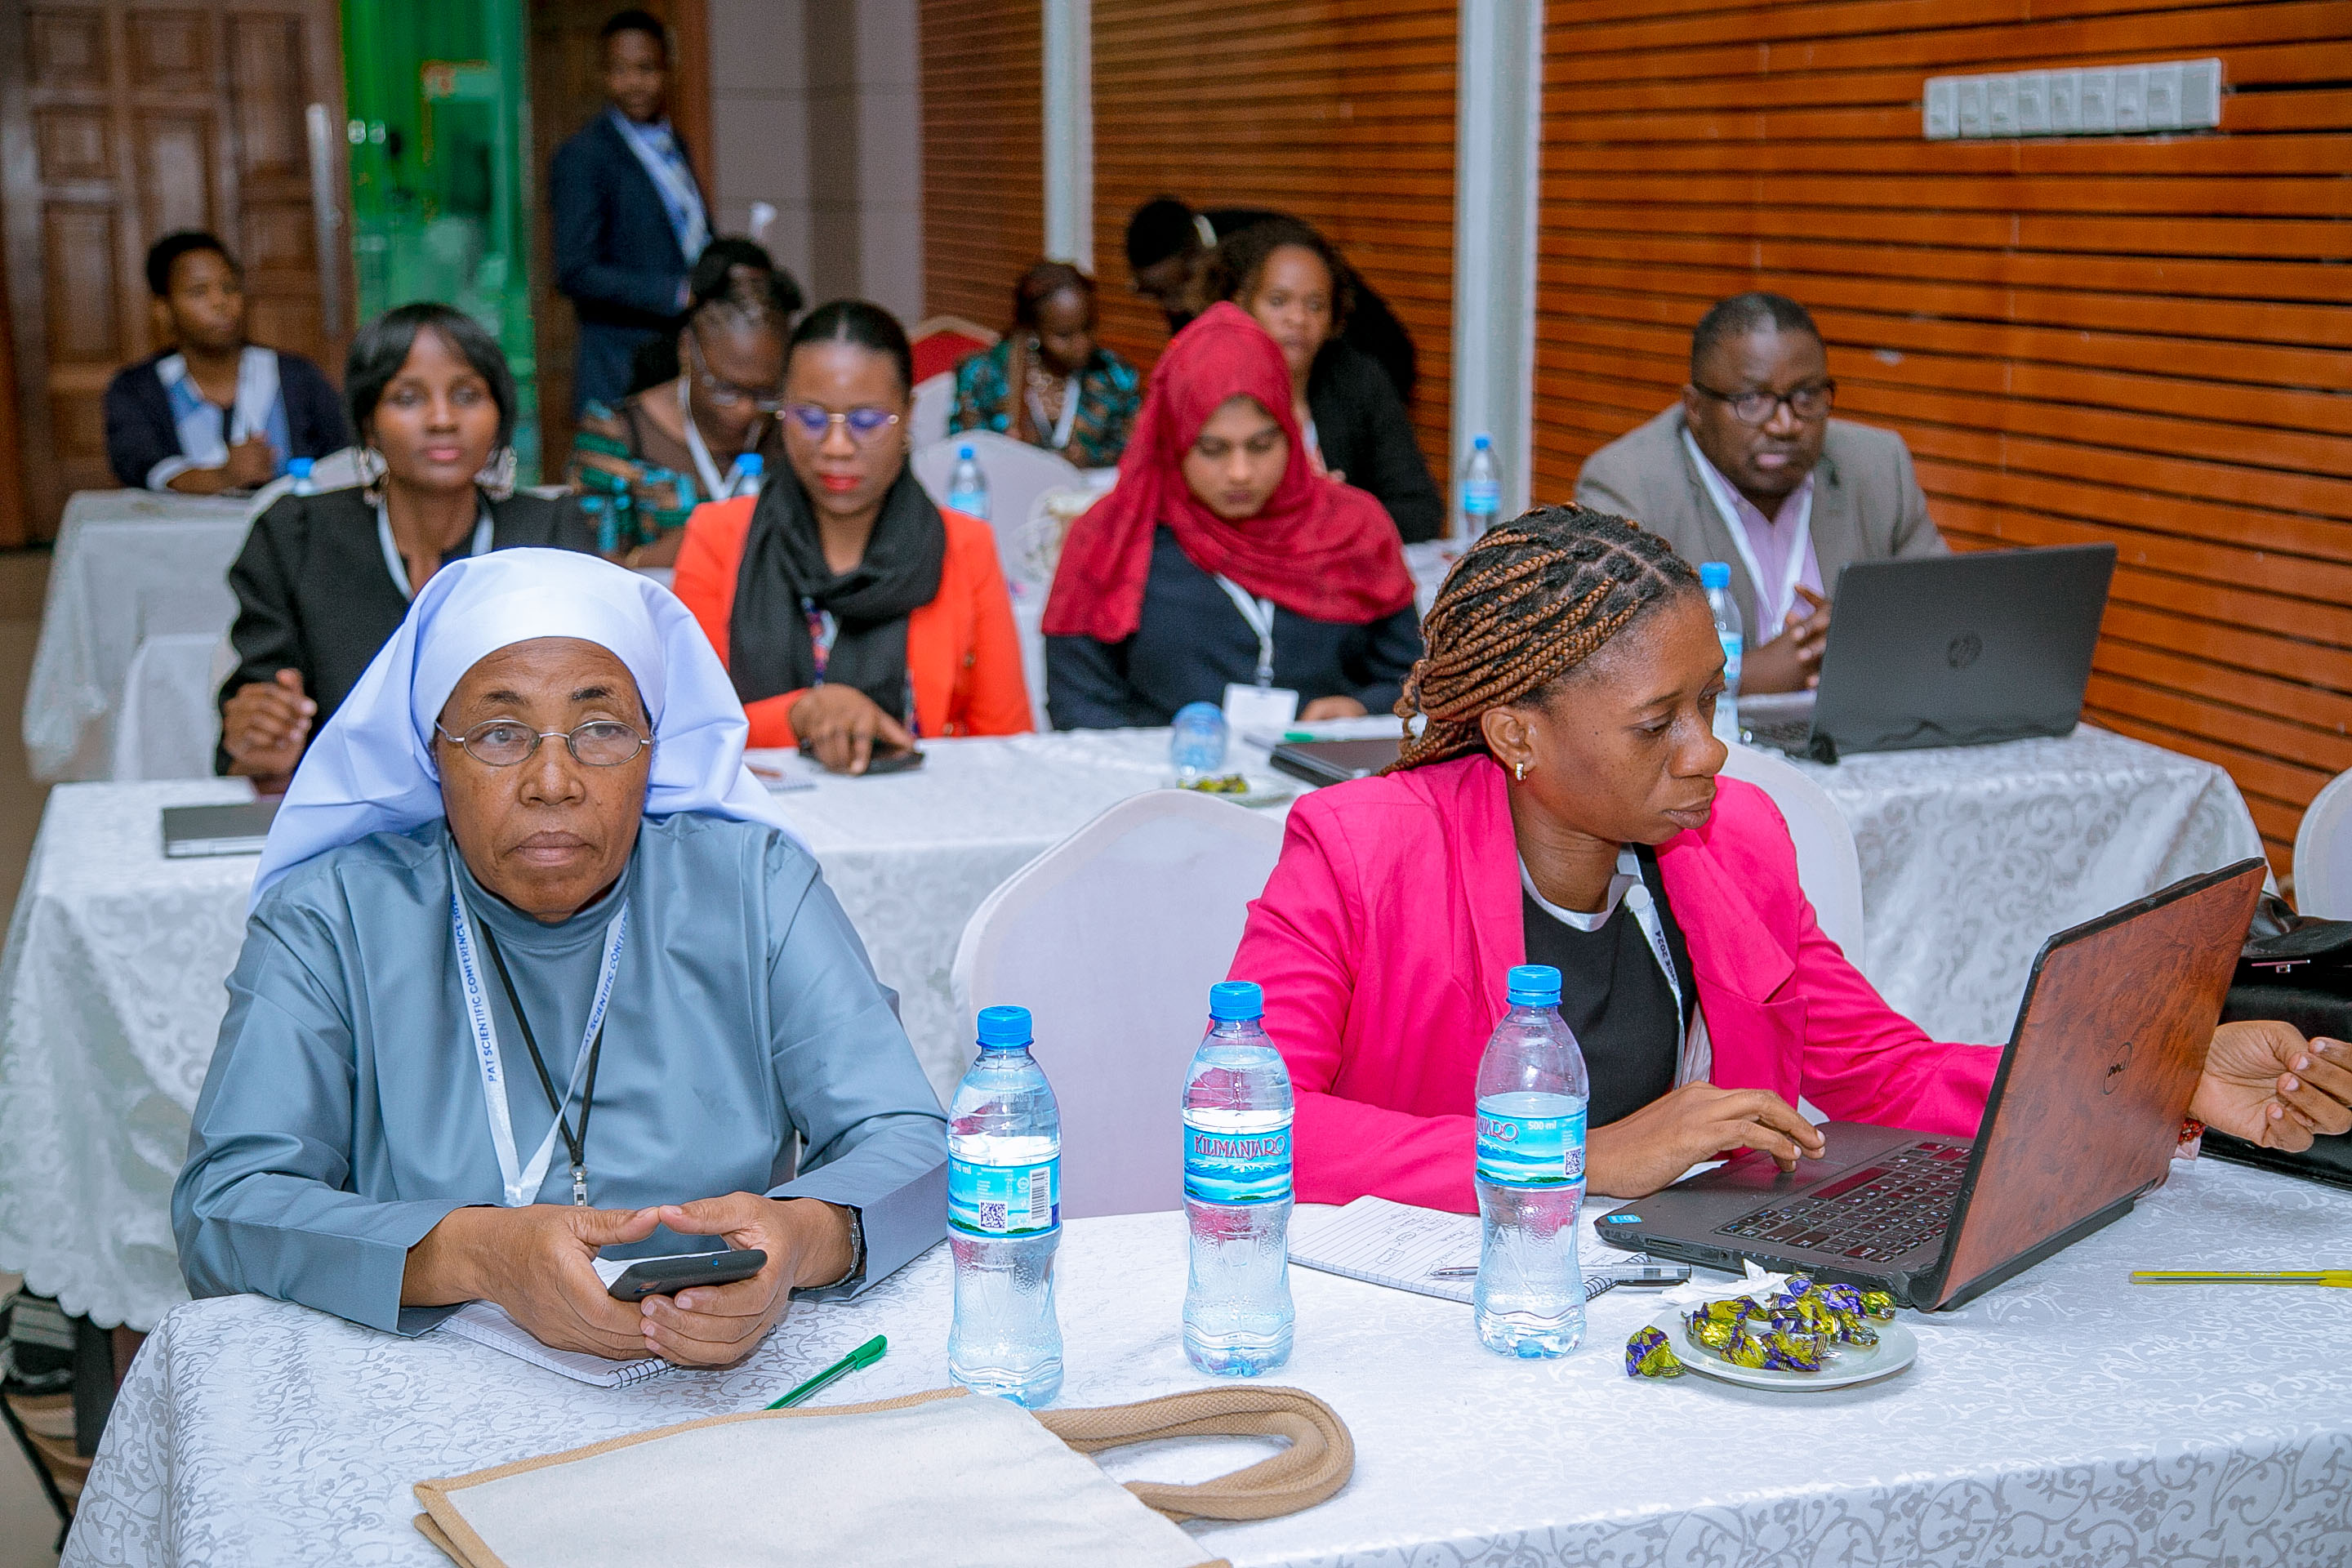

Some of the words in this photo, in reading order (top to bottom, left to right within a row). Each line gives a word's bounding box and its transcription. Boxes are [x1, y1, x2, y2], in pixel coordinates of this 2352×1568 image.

[1655, 930, 1668, 958] 2024
[457, 922, 479, 994] CONFERENCE
[590, 970, 615, 1030] SCIENTIFIC
[472, 996, 493, 1056] SCIENTIFIC
[485, 1058, 497, 1082] PAT
[1528, 1121, 1544, 1130] 500
[1195, 1134, 1286, 1160] KILIMANJARO
[962, 1166, 972, 1174] ml
